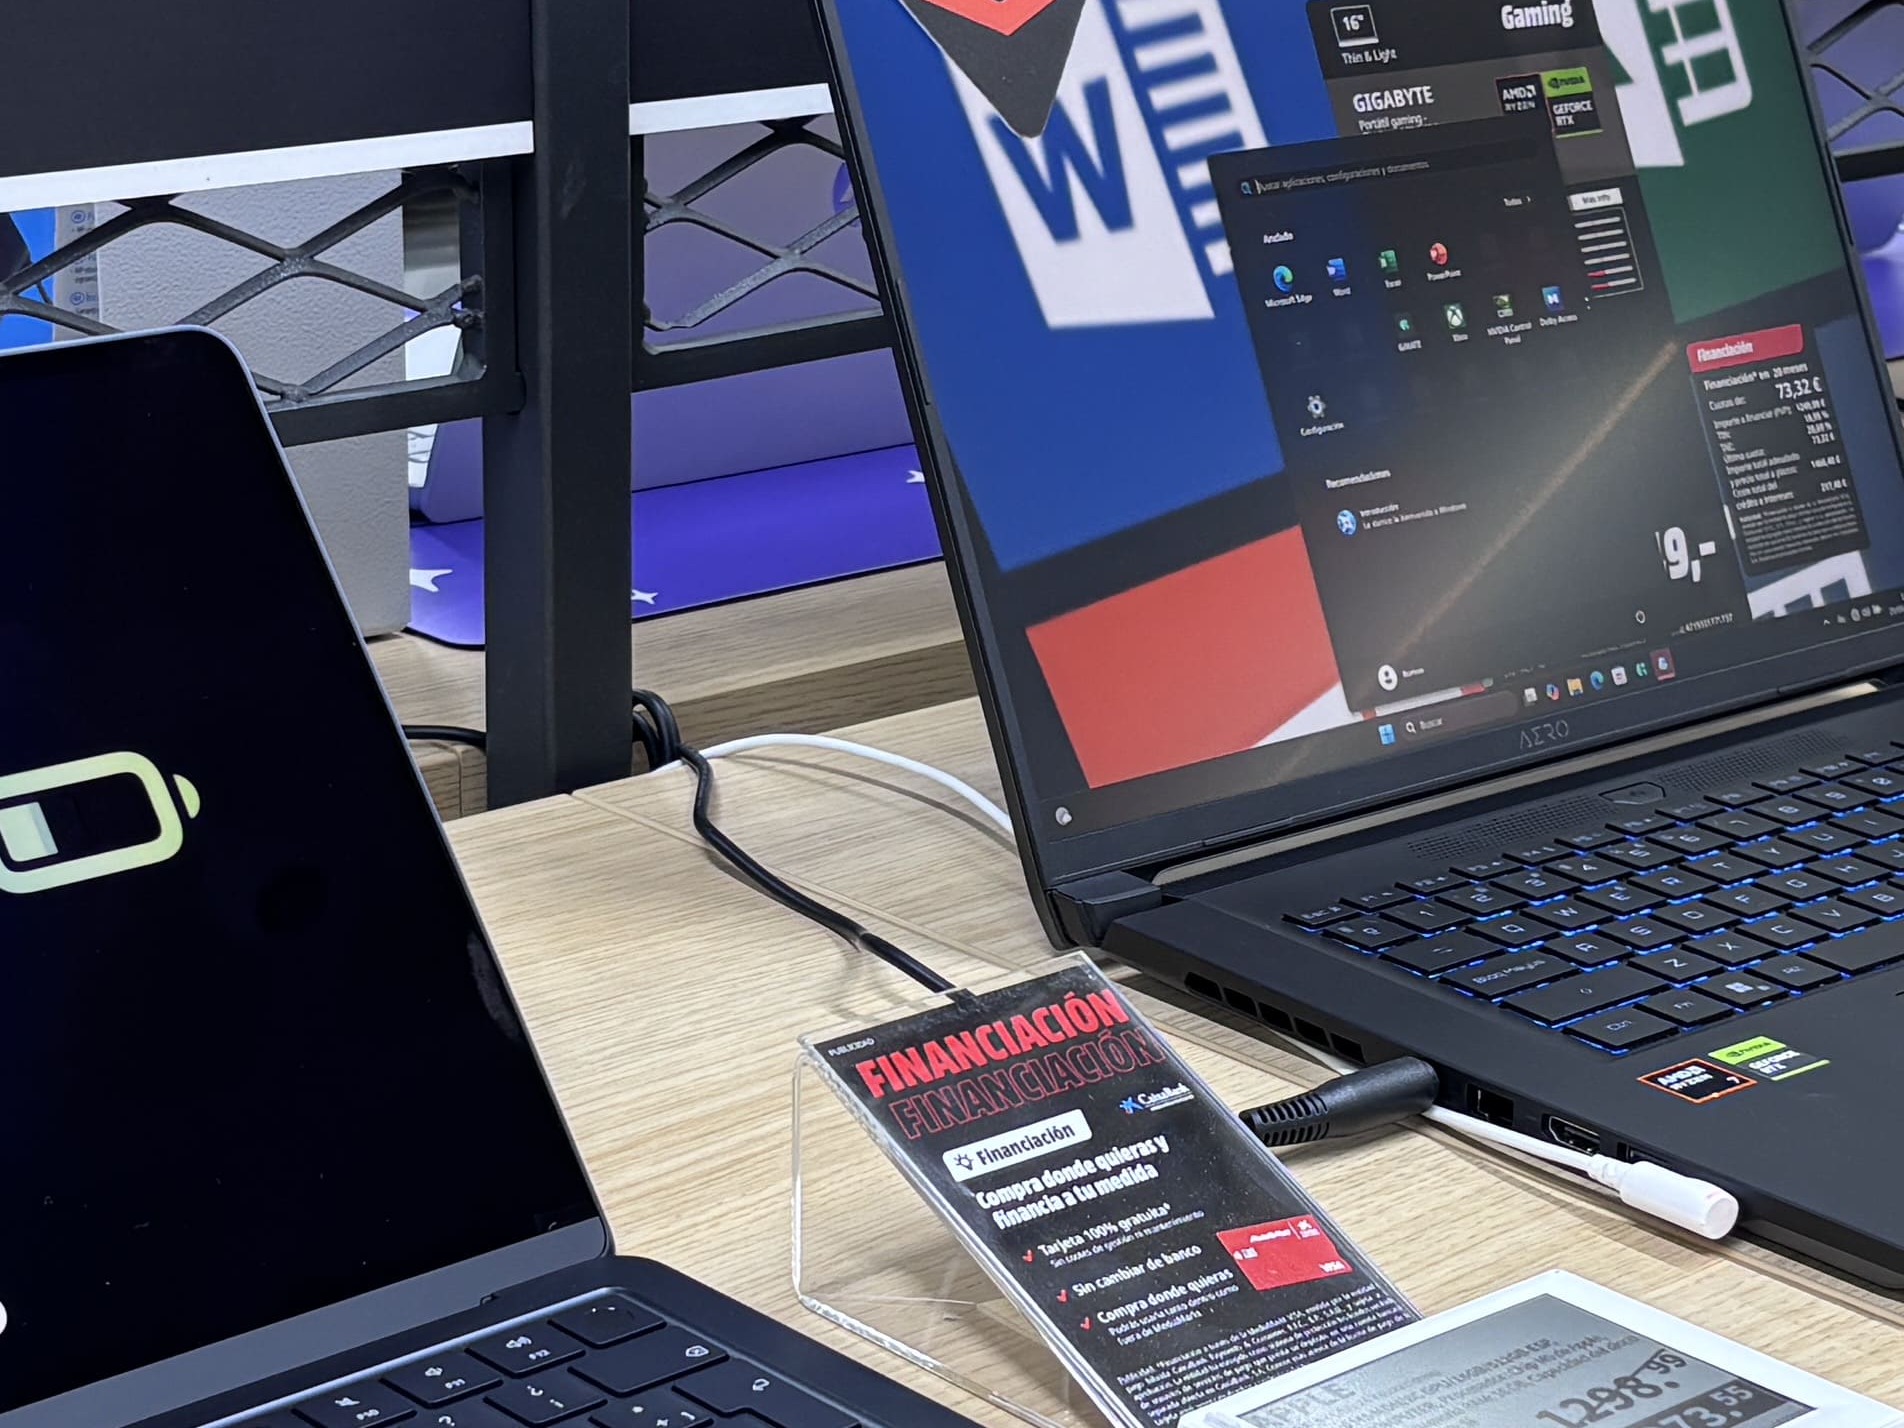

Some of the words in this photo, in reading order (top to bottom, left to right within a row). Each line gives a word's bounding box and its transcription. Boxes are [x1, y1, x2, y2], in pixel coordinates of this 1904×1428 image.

[1352, 85, 1435, 114] GIGABYTE
[1502, 85, 1528, 102] AMD
[1552, 99, 1594, 116] GEFORCE
[1556, 114, 1576, 128] RTX
[1696, 340, 1754, 363] Financiación
[1775, 378, 1813, 401] 73,32
[1812, 376, 1824, 393] €
[855, 988, 1130, 1099] FINANCIACIÓN
[1748, 1050, 1801, 1070] GEFORCE
[1760, 1063, 1788, 1075] RTX
[888, 1026, 1167, 1141] FINANCIACIÓN
[1657, 1064, 1698, 1087] AMD
[1726, 1076, 1740, 1085] 7
[976, 1122, 1076, 1167] Financiación
[975, 1178, 1045, 1210] Compra
[1043, 1158, 1097, 1193] donde
[1093, 1143, 1153, 1178] quieras
[1151, 1133, 1171, 1154] y
[992, 1195, 1063, 1230] financia
[1071, 1181, 1098, 1202] tu
[1095, 1160, 1159, 1194] medida
[1037, 1232, 1086, 1257] Tarjeta
[1082, 1221, 1118, 1243] 100%
[1071, 1281, 1096, 1298] Sin
[1095, 1264, 1146, 1291] cambiar
[1145, 1255, 1164, 1272] de
[1162, 1244, 1203, 1266] banco
[1096, 1298, 1148, 1324] Compra
[1147, 1283, 1188, 1309] donde
[1187, 1267, 1235, 1296] quieras
